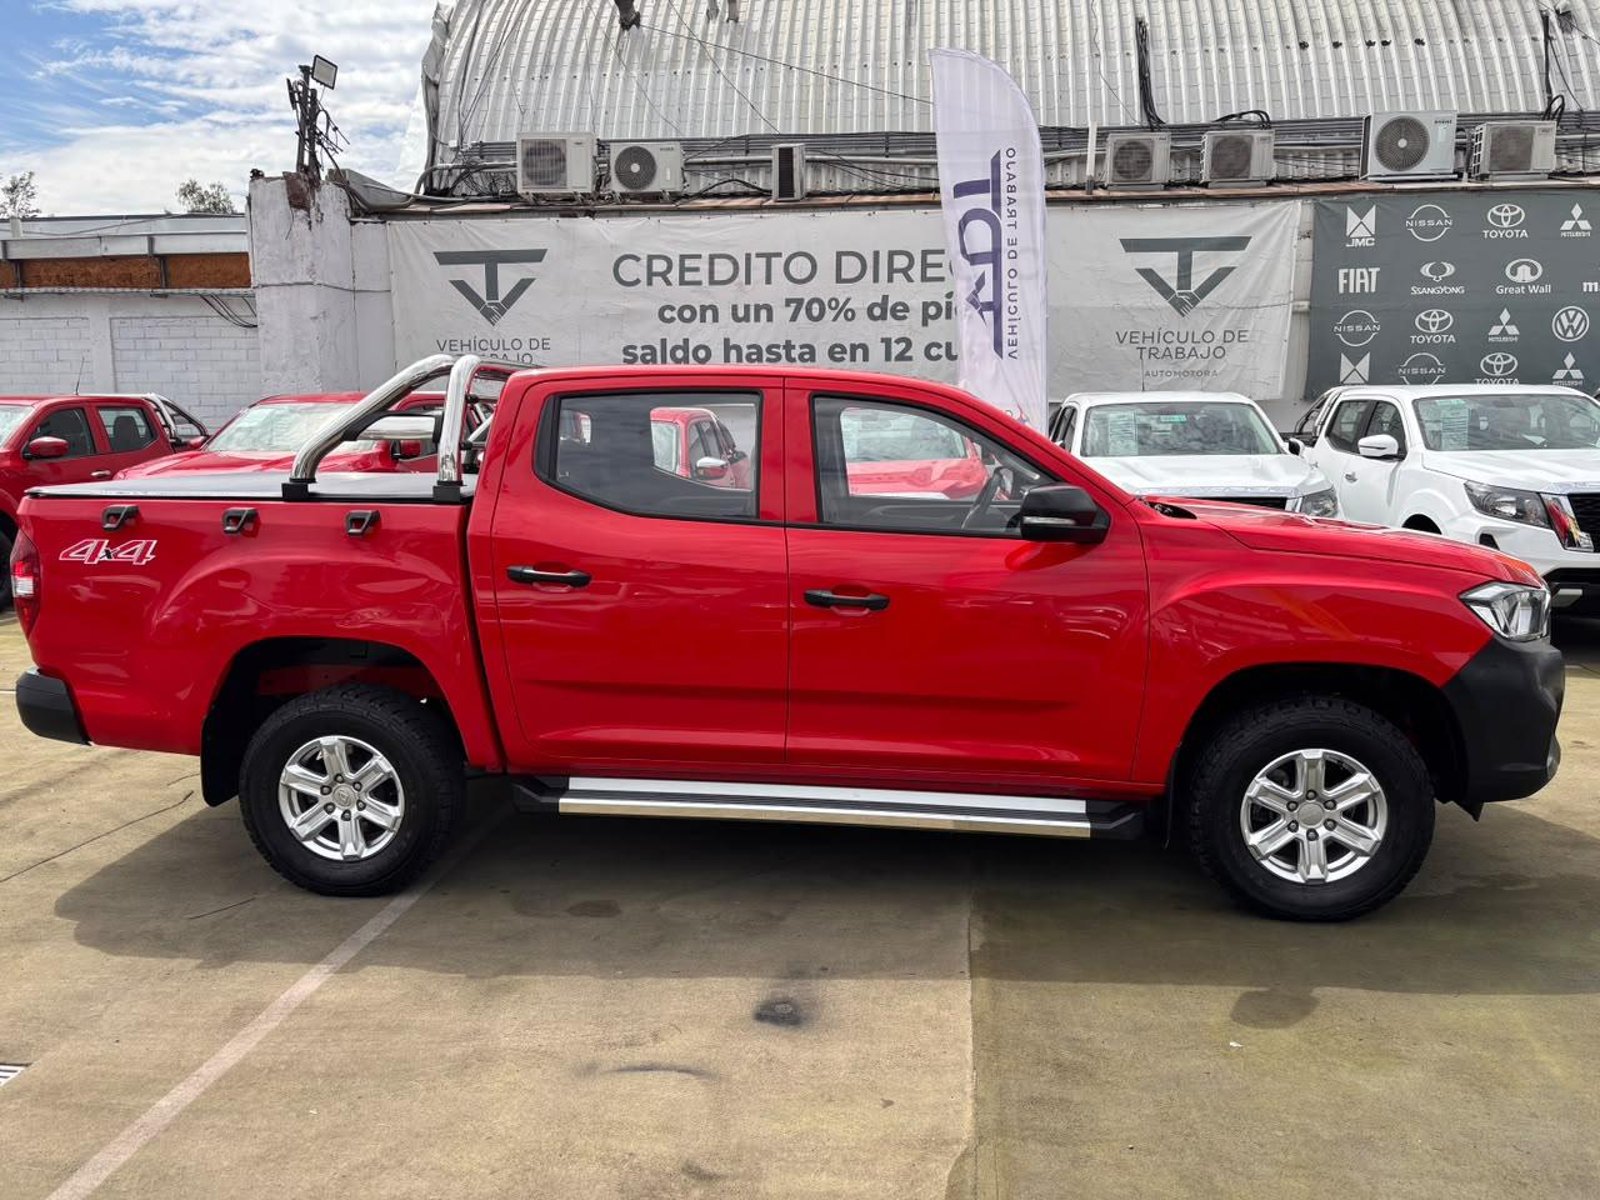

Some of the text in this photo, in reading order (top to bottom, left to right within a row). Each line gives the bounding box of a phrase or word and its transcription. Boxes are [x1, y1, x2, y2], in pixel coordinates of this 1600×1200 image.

[1405, 219, 1453, 228] NISSAN
[1483, 229, 1529, 239] TOYOTA
[1345, 238, 1375, 247] JMC
[612, 249, 954, 287] CREDITO DIRE
[1338, 267, 1380, 293] FIAT
[1496, 284, 1551, 295] Great Wall
[658, 291, 957, 327] con un 70% de pí
[1334, 324, 1380, 333] NISSAN
[1115, 327, 1249, 344] VEHÍCULO DE
[1410, 335, 1456, 344] TOYOTA
[436, 336, 551, 352] VEHÍCULO DE
[622, 338, 712, 364] saldo
[723, 338, 816, 363] hasta
[828, 342, 870, 363] en
[880, 337, 913, 362] 12
[1136, 346, 1226, 360] TRABAJO
[1144, 369, 1218, 378] AUTOMOTORA
[1399, 365, 1446, 374] NISSAN
[59, 539, 158, 565] 4x4
